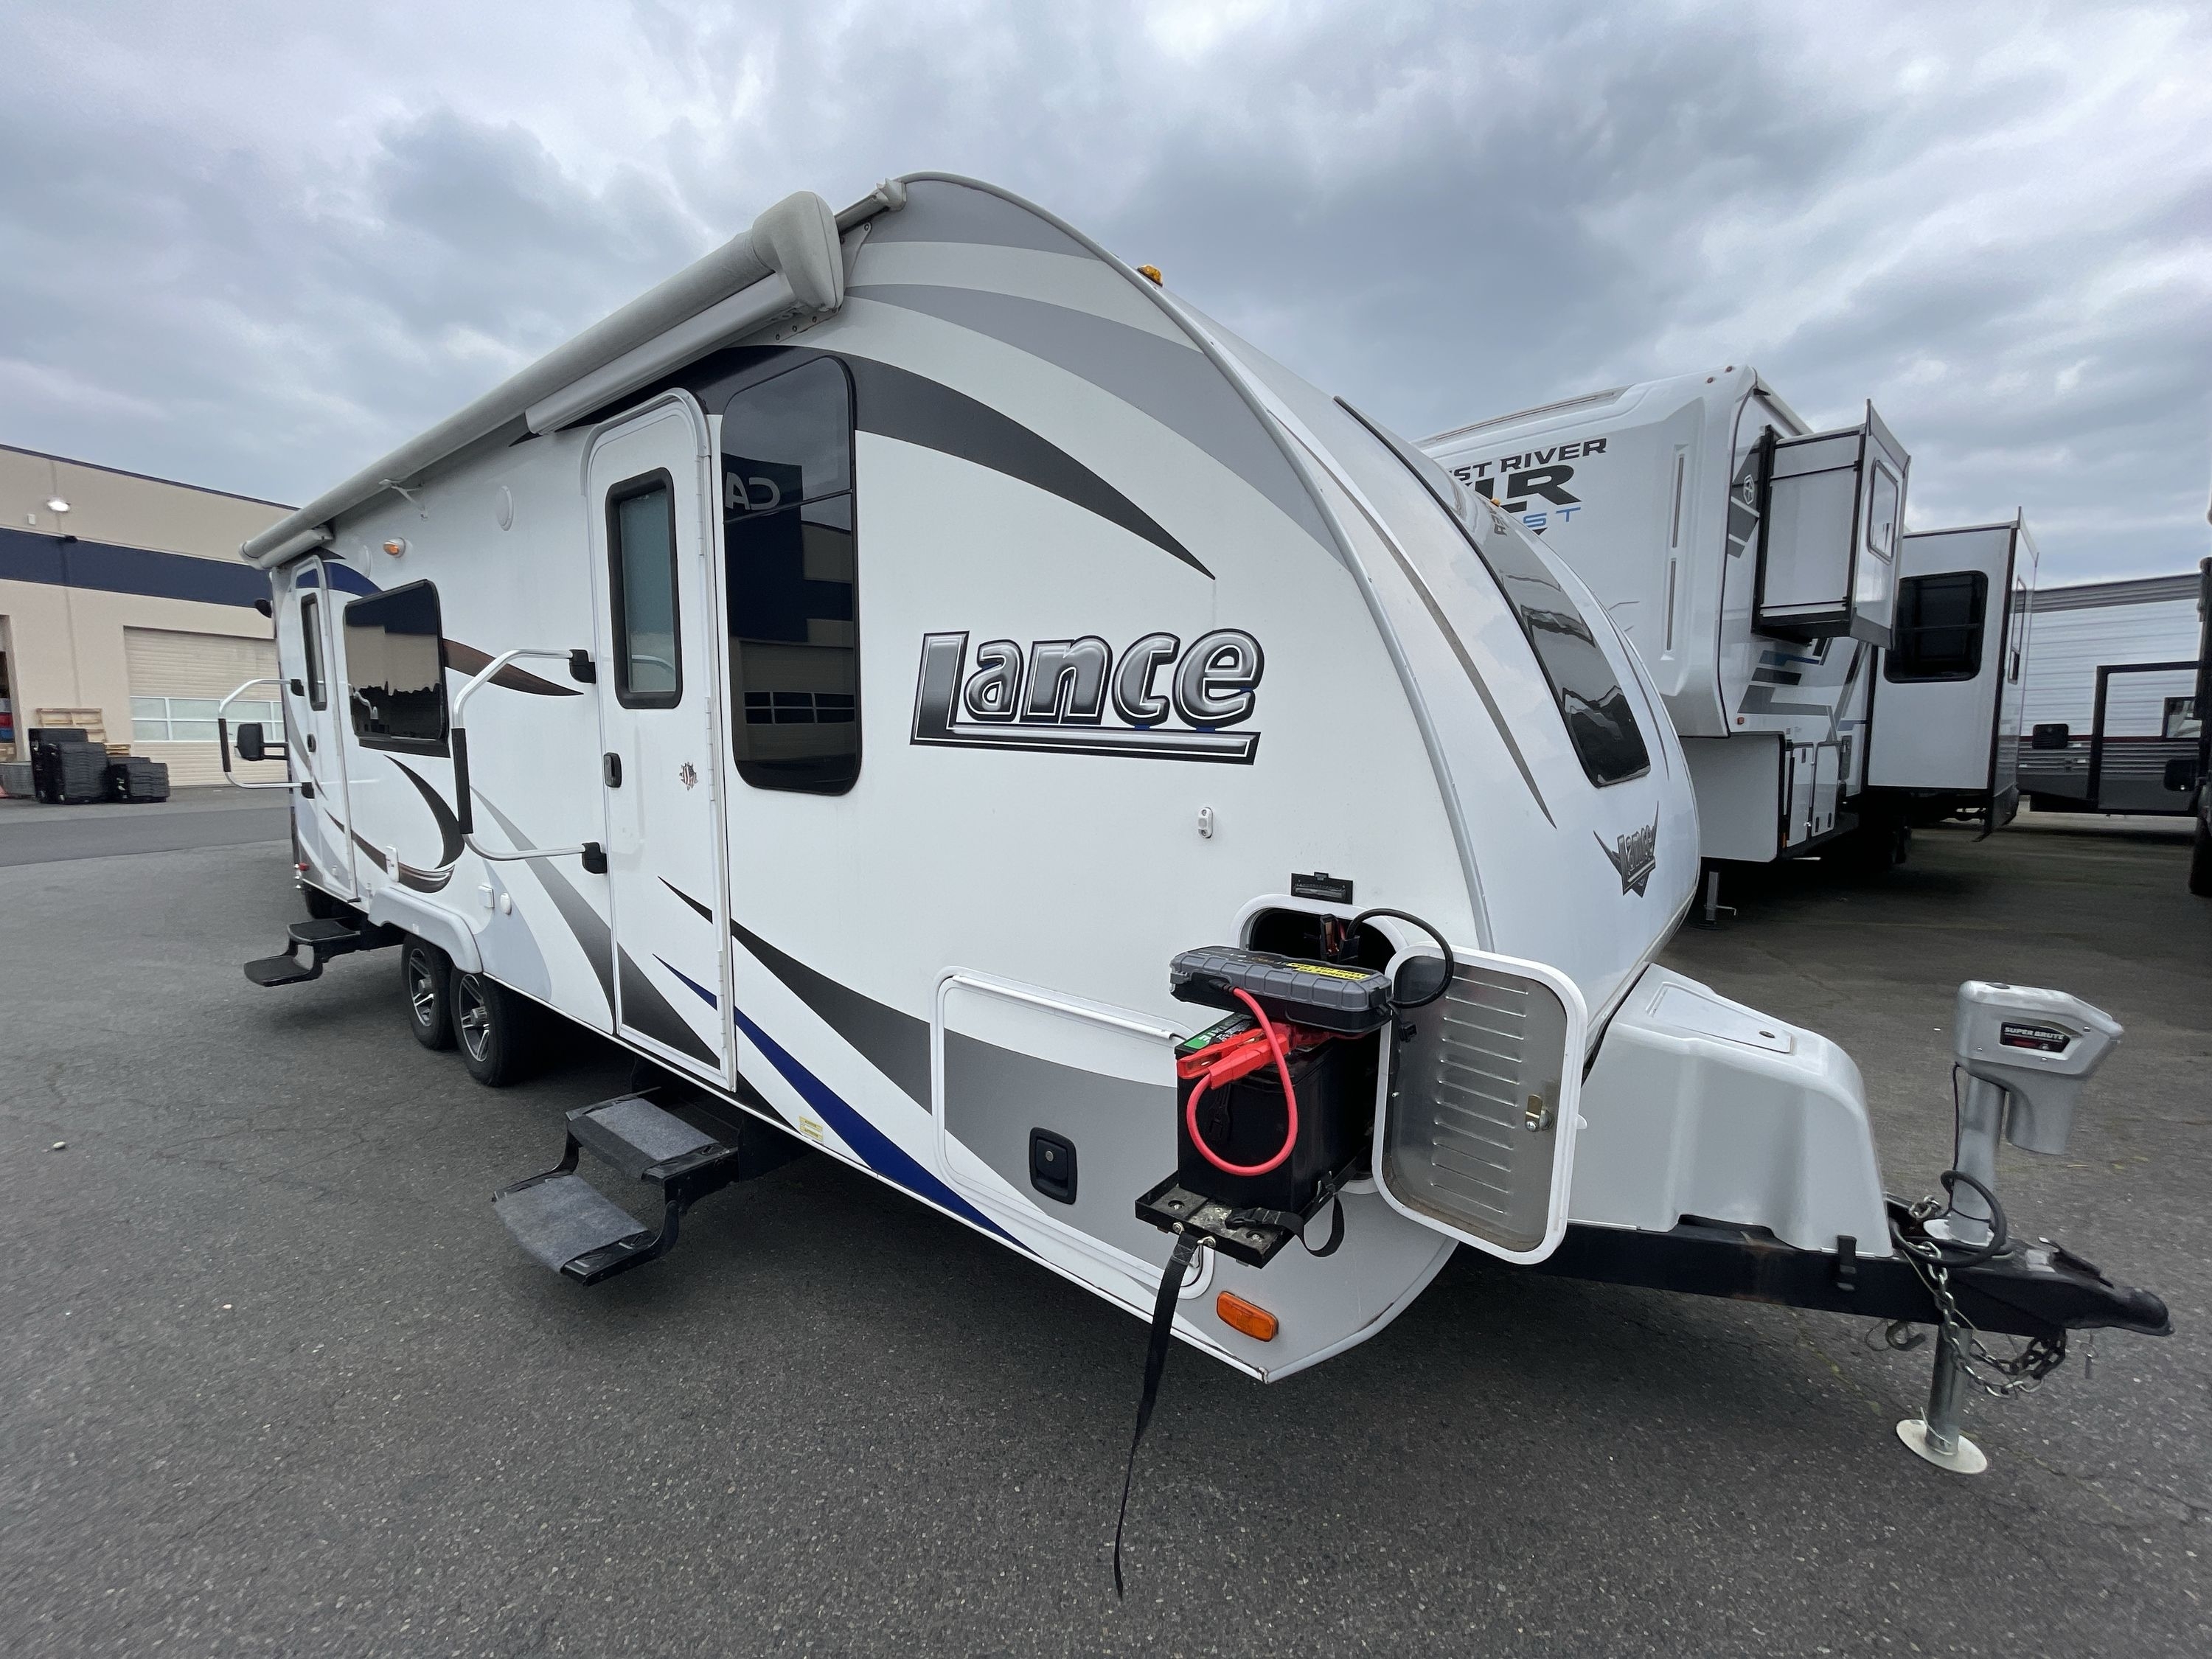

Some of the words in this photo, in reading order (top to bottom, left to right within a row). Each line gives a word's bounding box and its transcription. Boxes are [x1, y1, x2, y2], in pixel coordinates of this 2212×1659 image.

[1500, 438, 1607, 473] RIVER
[910, 627, 1265, 765] Lance
[2004, 1026, 2034, 1036] SUPER
